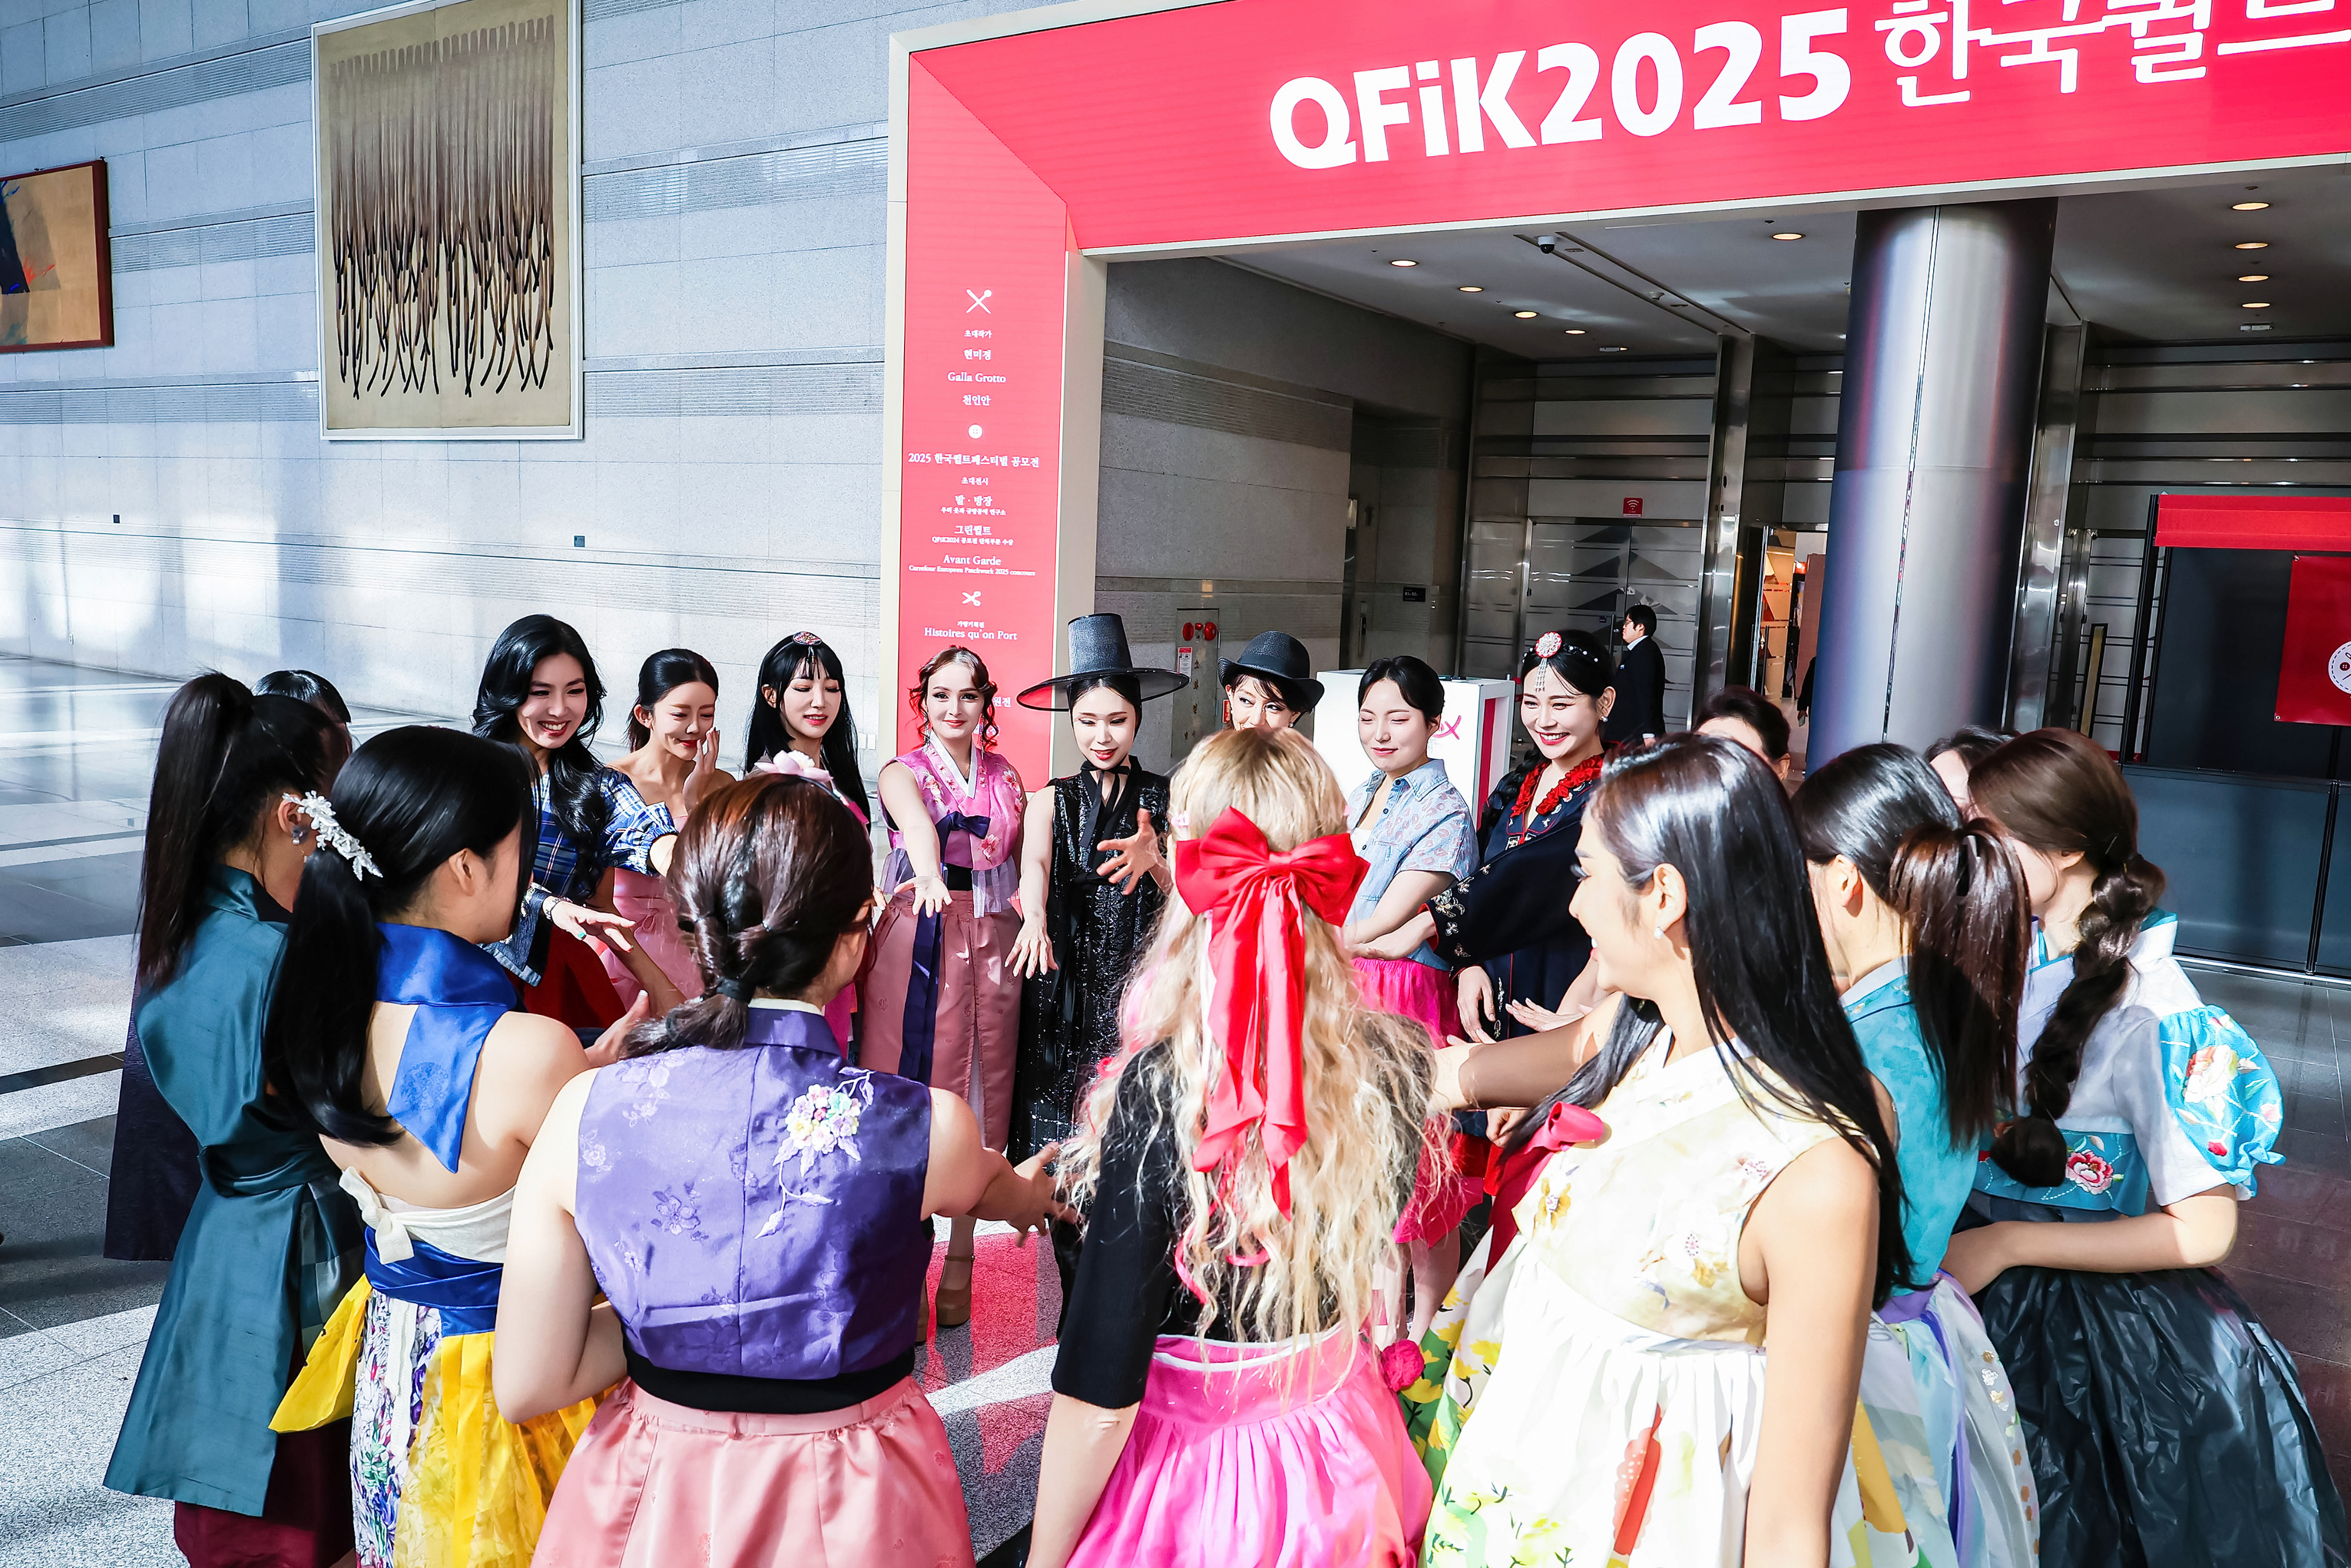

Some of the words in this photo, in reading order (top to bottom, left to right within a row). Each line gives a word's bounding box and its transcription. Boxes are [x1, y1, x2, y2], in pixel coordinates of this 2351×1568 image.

[1270, 8, 1852, 169] QFiK2025
[964, 329, 992, 339] 초대작가
[963, 348, 991, 360] 현미경
[948, 371, 973, 382] Galla
[975, 372, 1006, 383] Grotto
[963, 394, 991, 406] 천인안
[908, 453, 932, 463] 2025
[934, 453, 1008, 467] 한국퀼트페스티벌
[1011, 456, 1039, 468] 공모전
[961, 476, 988, 486] 초대전시
[954, 525, 992, 536] 그린퀼트
[943, 554, 971, 565] Avant
[972, 556, 1002, 566] Garde
[924, 627, 965, 638] Histoires
[967, 628, 995, 640] qu'on
[997, 630, 1018, 641] Port
